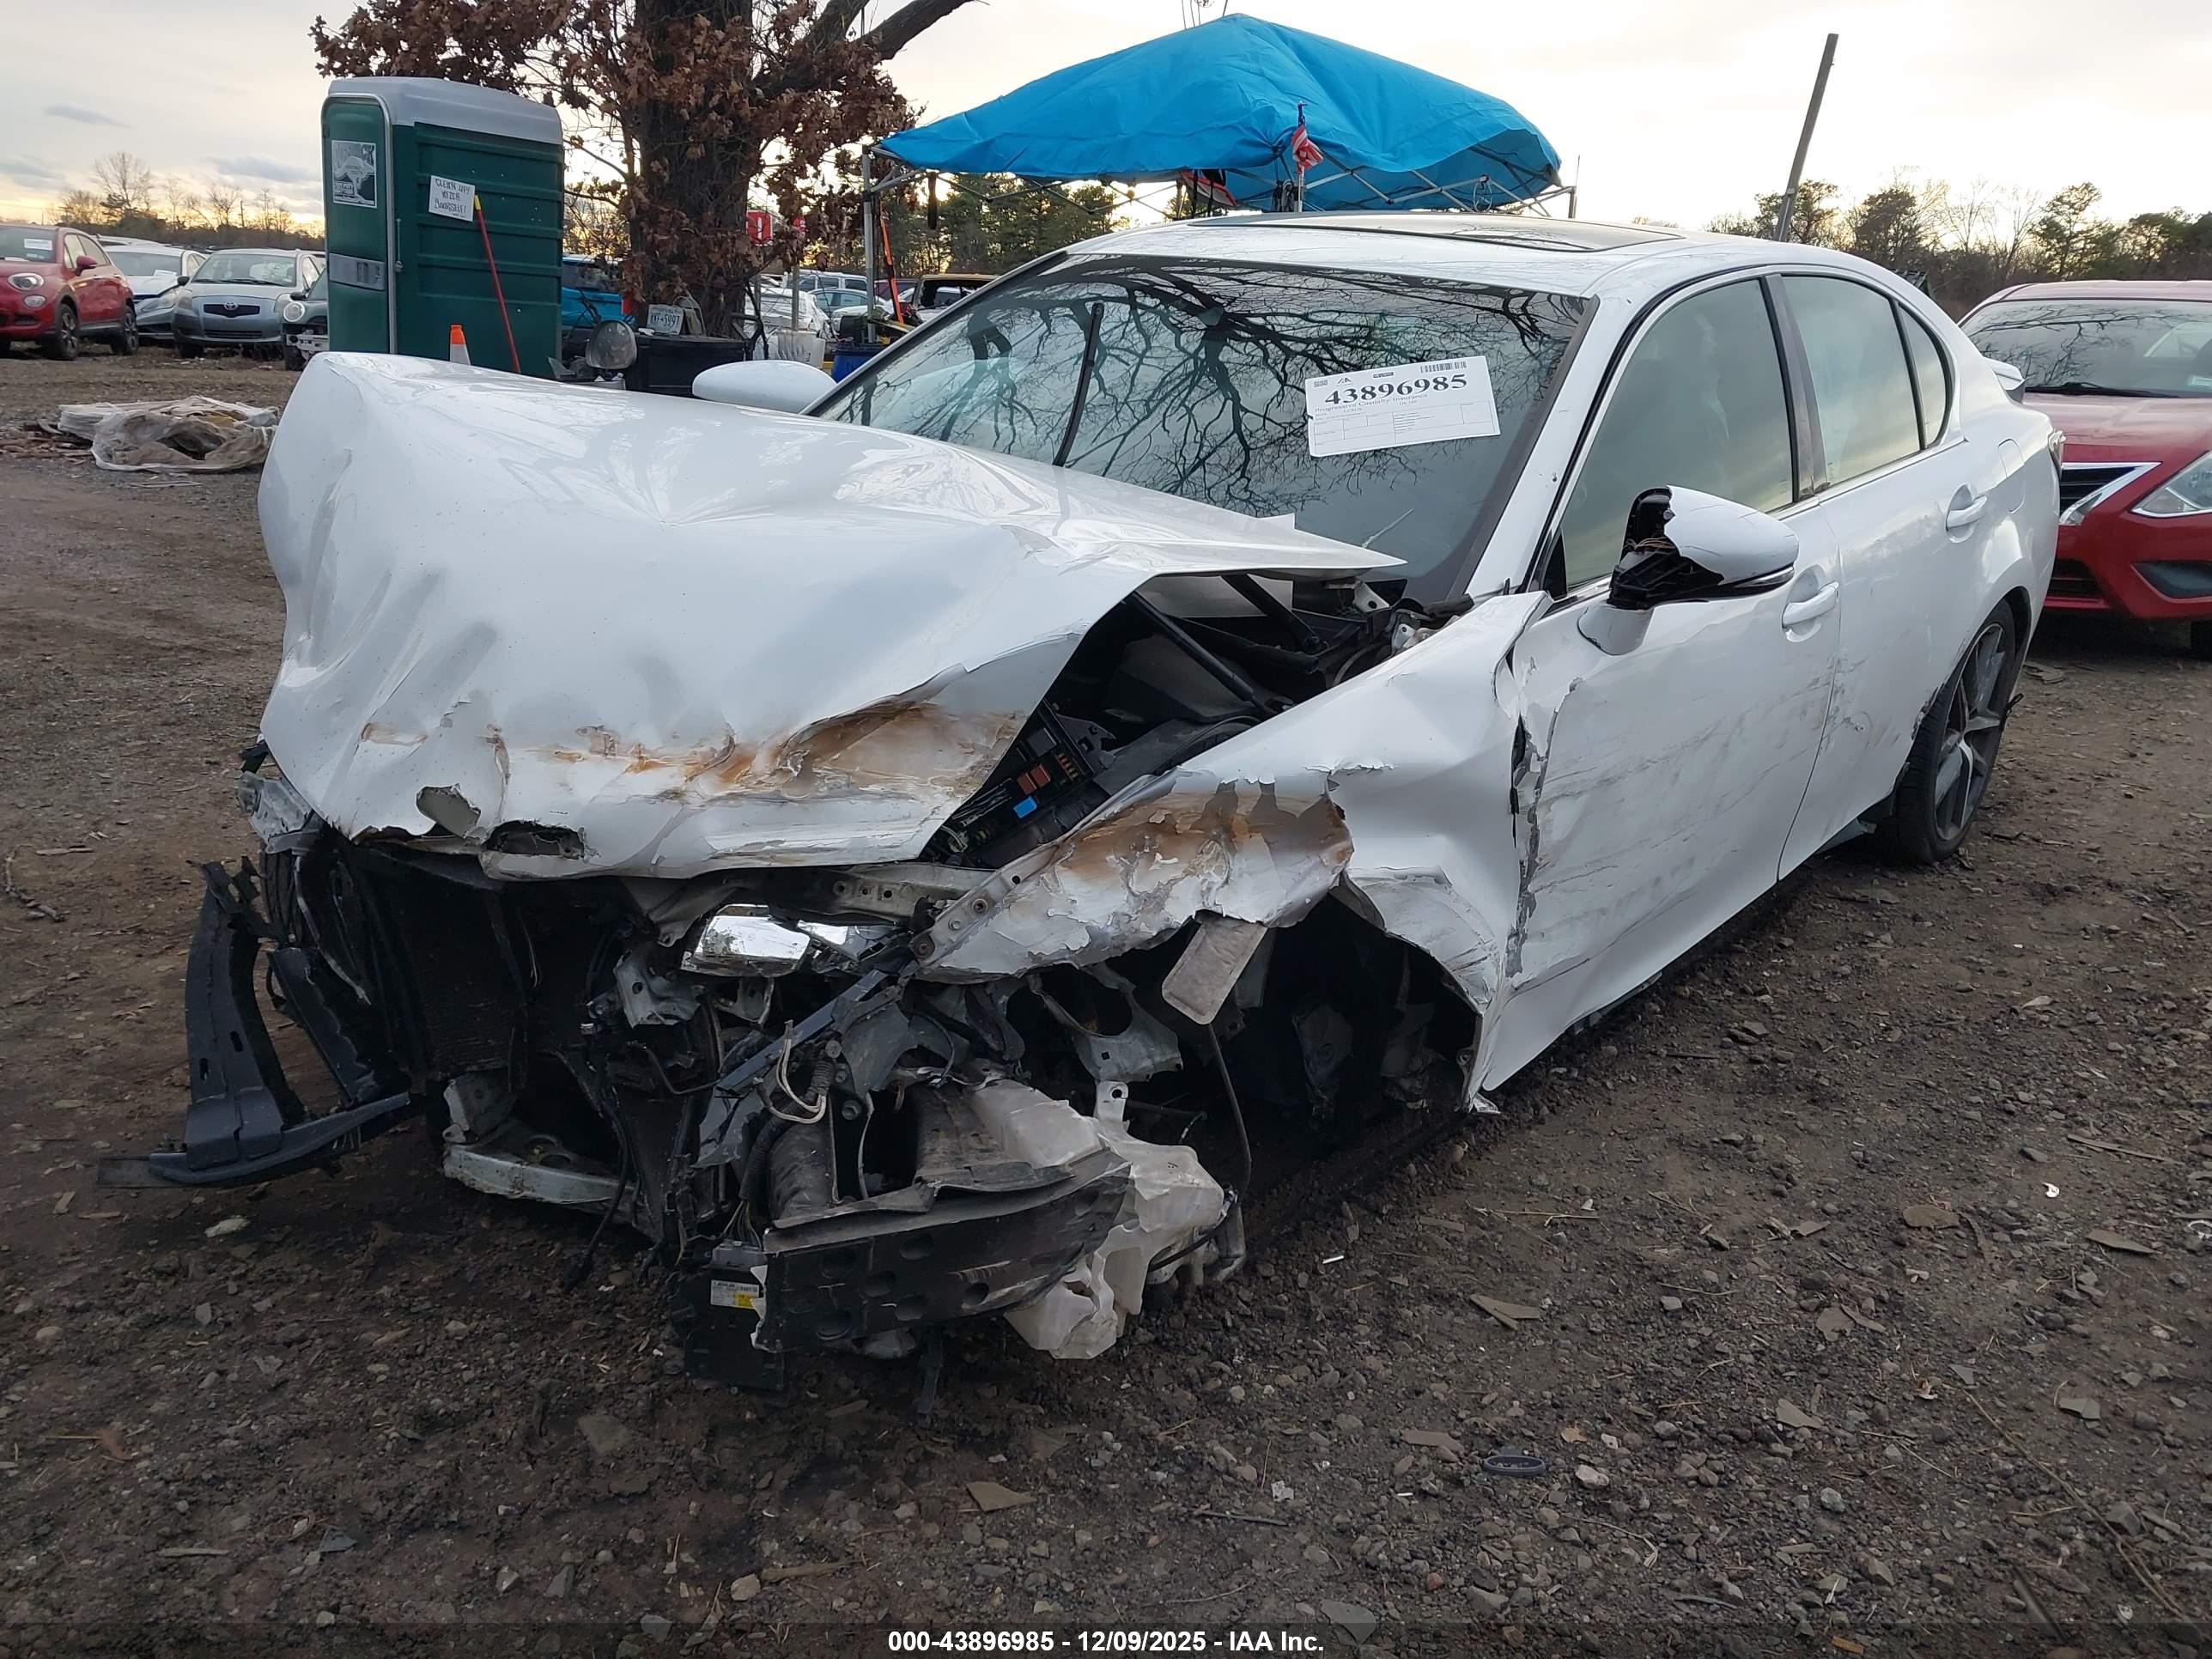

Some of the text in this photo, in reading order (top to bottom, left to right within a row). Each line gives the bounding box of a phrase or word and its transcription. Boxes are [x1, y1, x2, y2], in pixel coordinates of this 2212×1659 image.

[1325, 374, 1468, 404] 43896985
[1315, 403, 1357, 413] Progressive
[1393, 393, 1428, 402] Insurance
